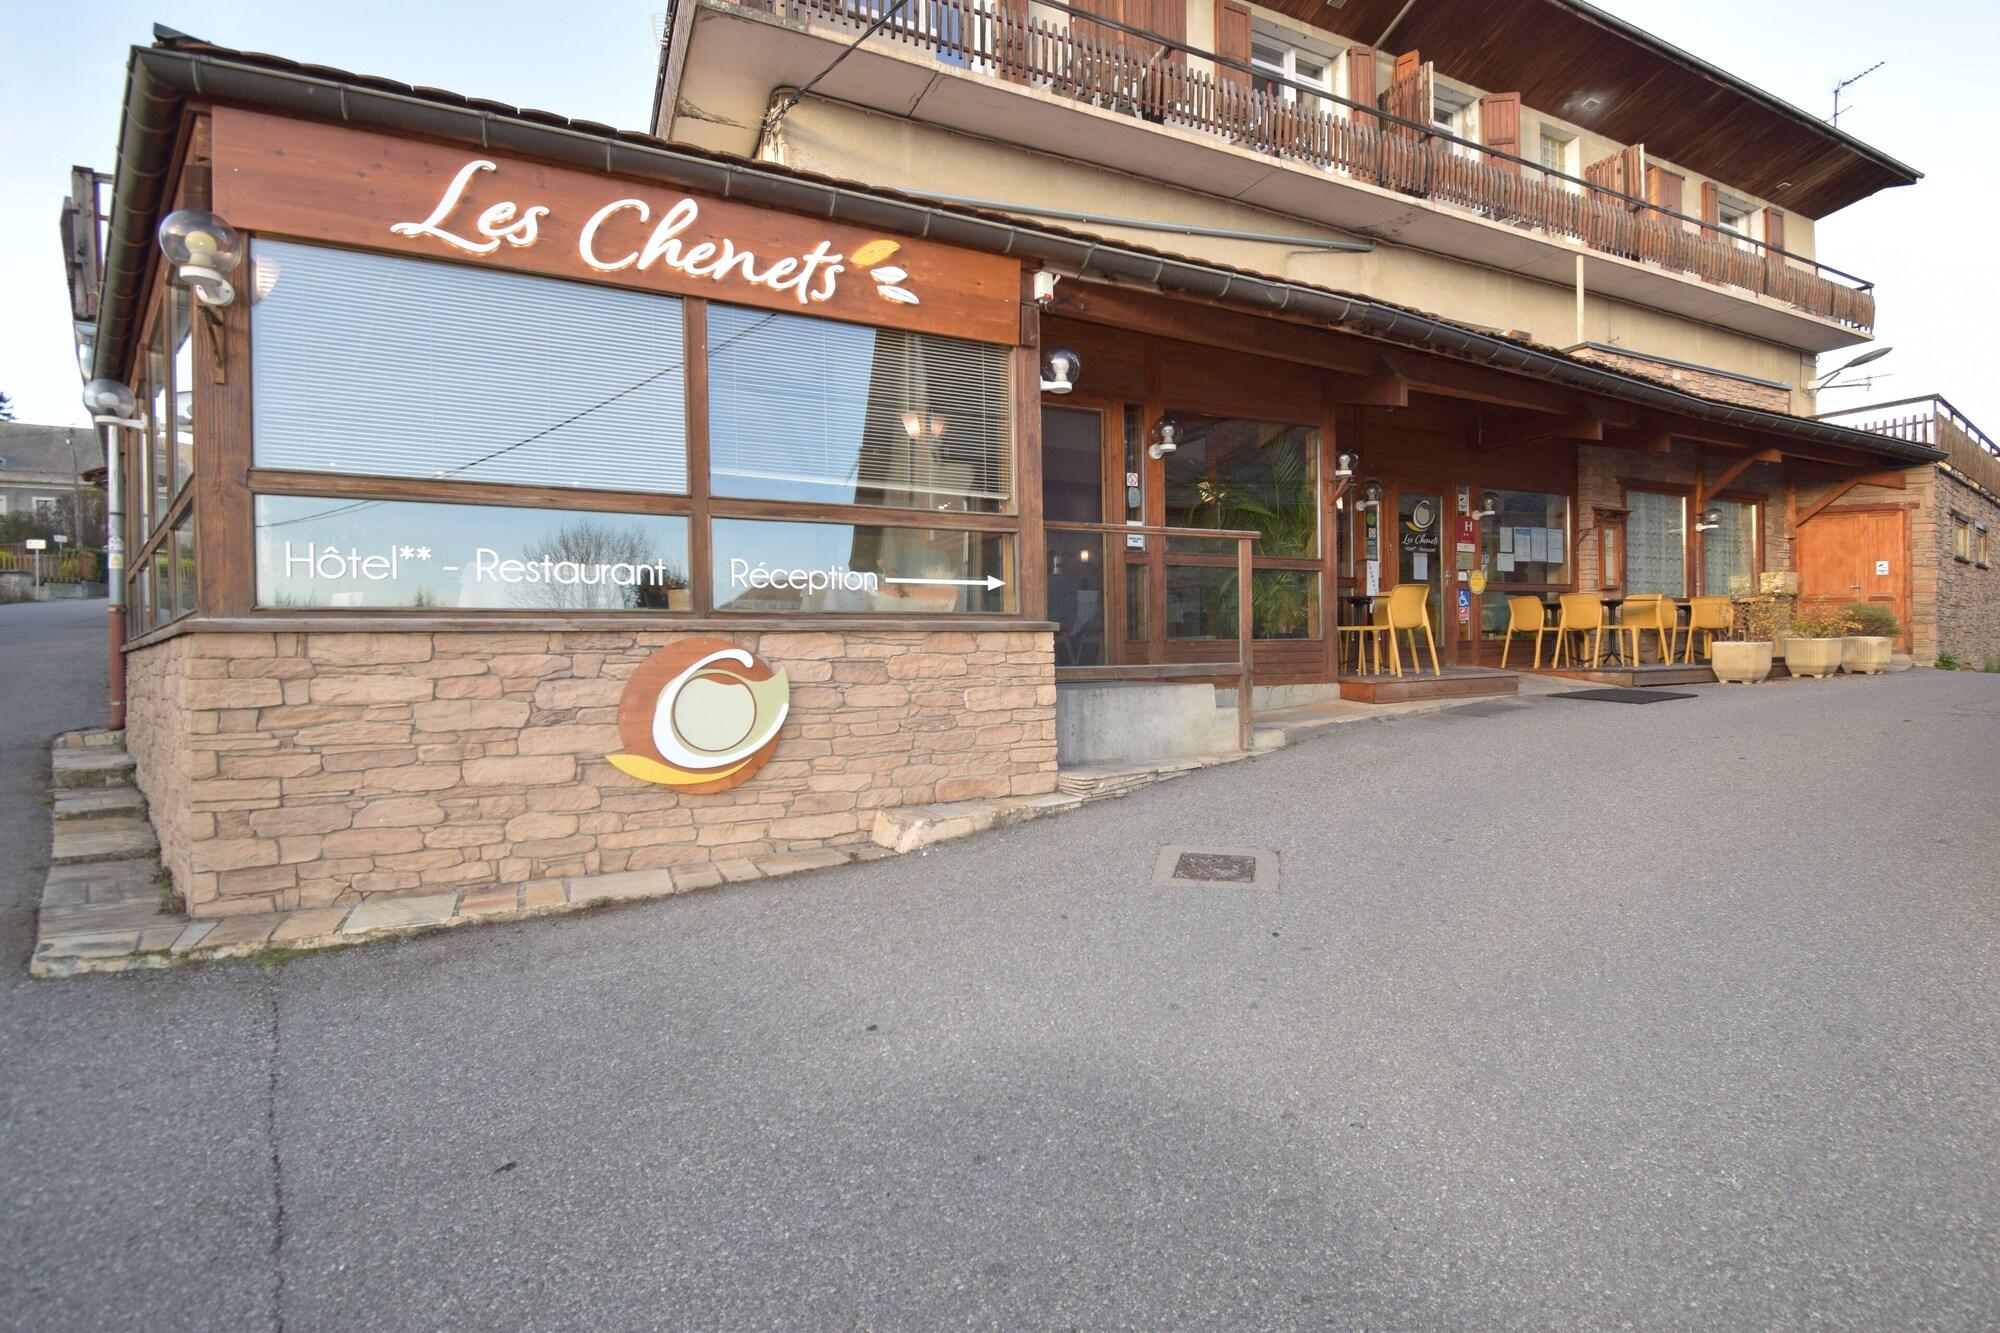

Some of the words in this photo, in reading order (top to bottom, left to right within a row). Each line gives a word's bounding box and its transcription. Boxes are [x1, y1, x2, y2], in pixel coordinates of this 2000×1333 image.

[390, 159, 550, 254] Les
[578, 197, 846, 305] Chenets
[1465, 521, 1473, 532] H
[475, 547, 668, 588] Restaurant
[729, 556, 880, 597] Réception
